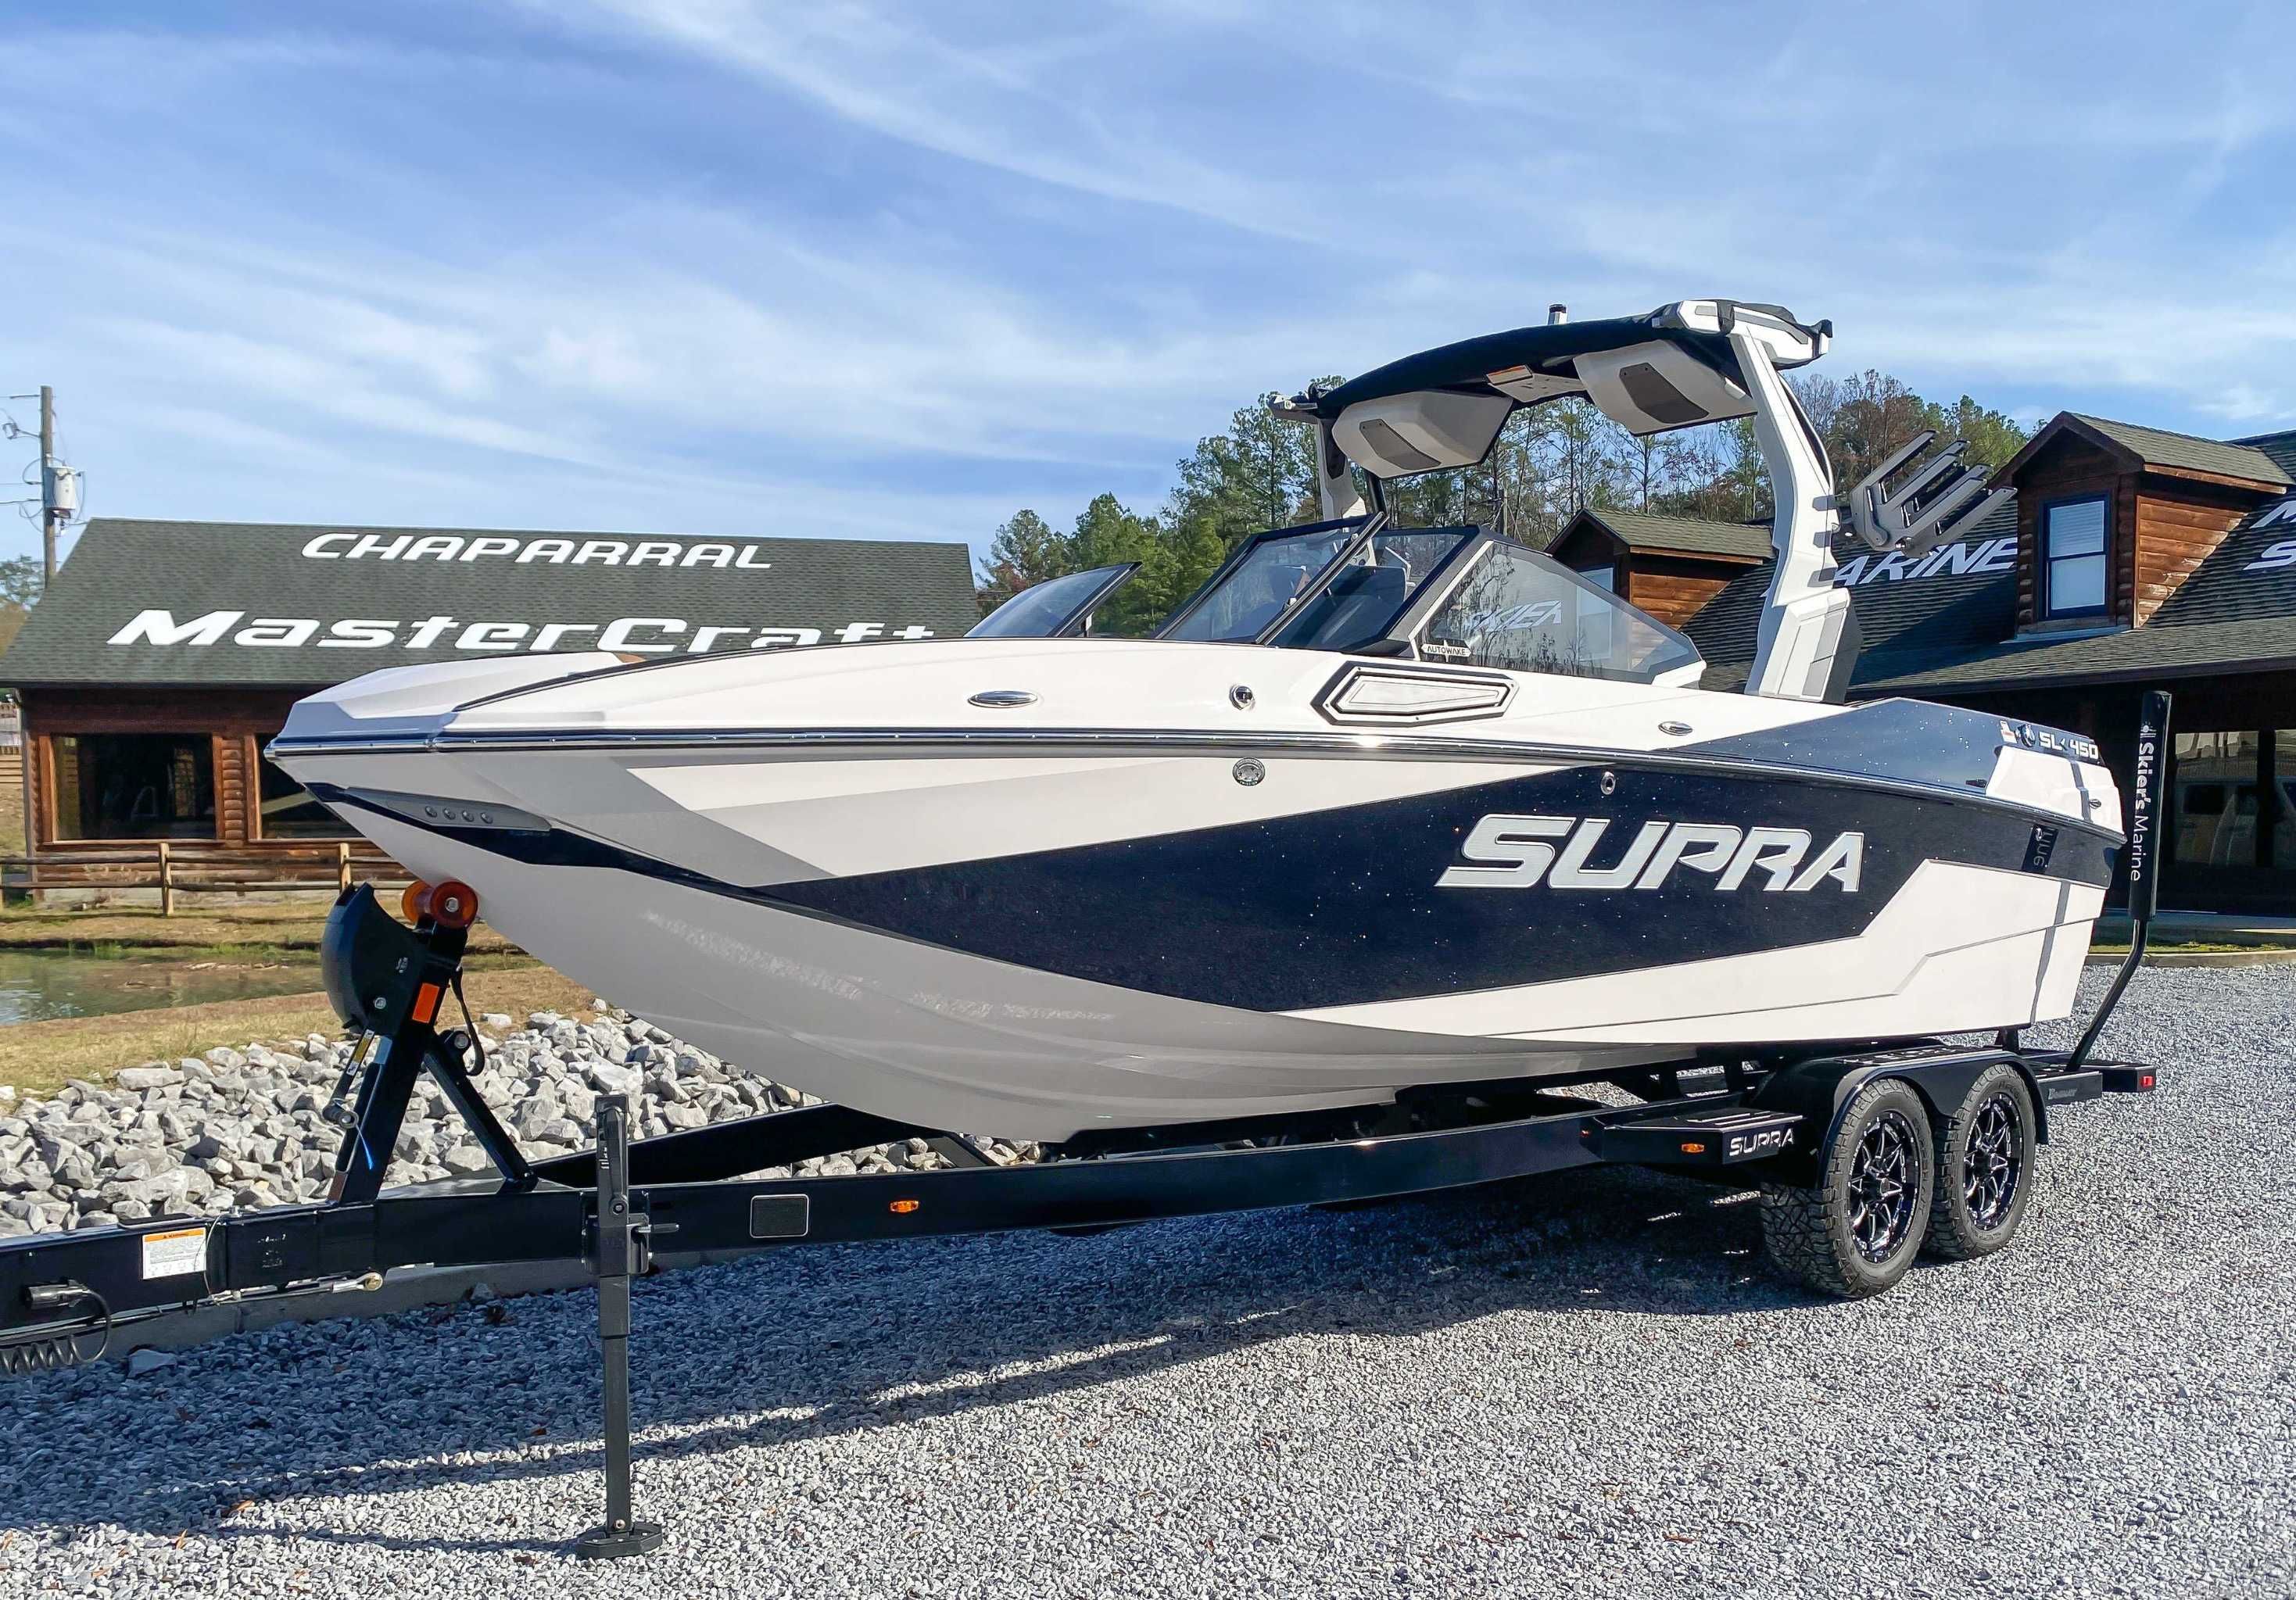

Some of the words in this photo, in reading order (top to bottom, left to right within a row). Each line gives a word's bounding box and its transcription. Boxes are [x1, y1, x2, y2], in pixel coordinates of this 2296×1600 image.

[301, 532, 772, 569] CHAPARRAL
[1426, 646, 1467, 657] AUTOWAKE
[2069, 739, 2099, 760] 450
[2135, 743, 2155, 811] Skier's
[1434, 813, 1864, 893] SUPRA
[2130, 815, 2149, 882] Marine
[1728, 1128, 1794, 1157] SUPRA
